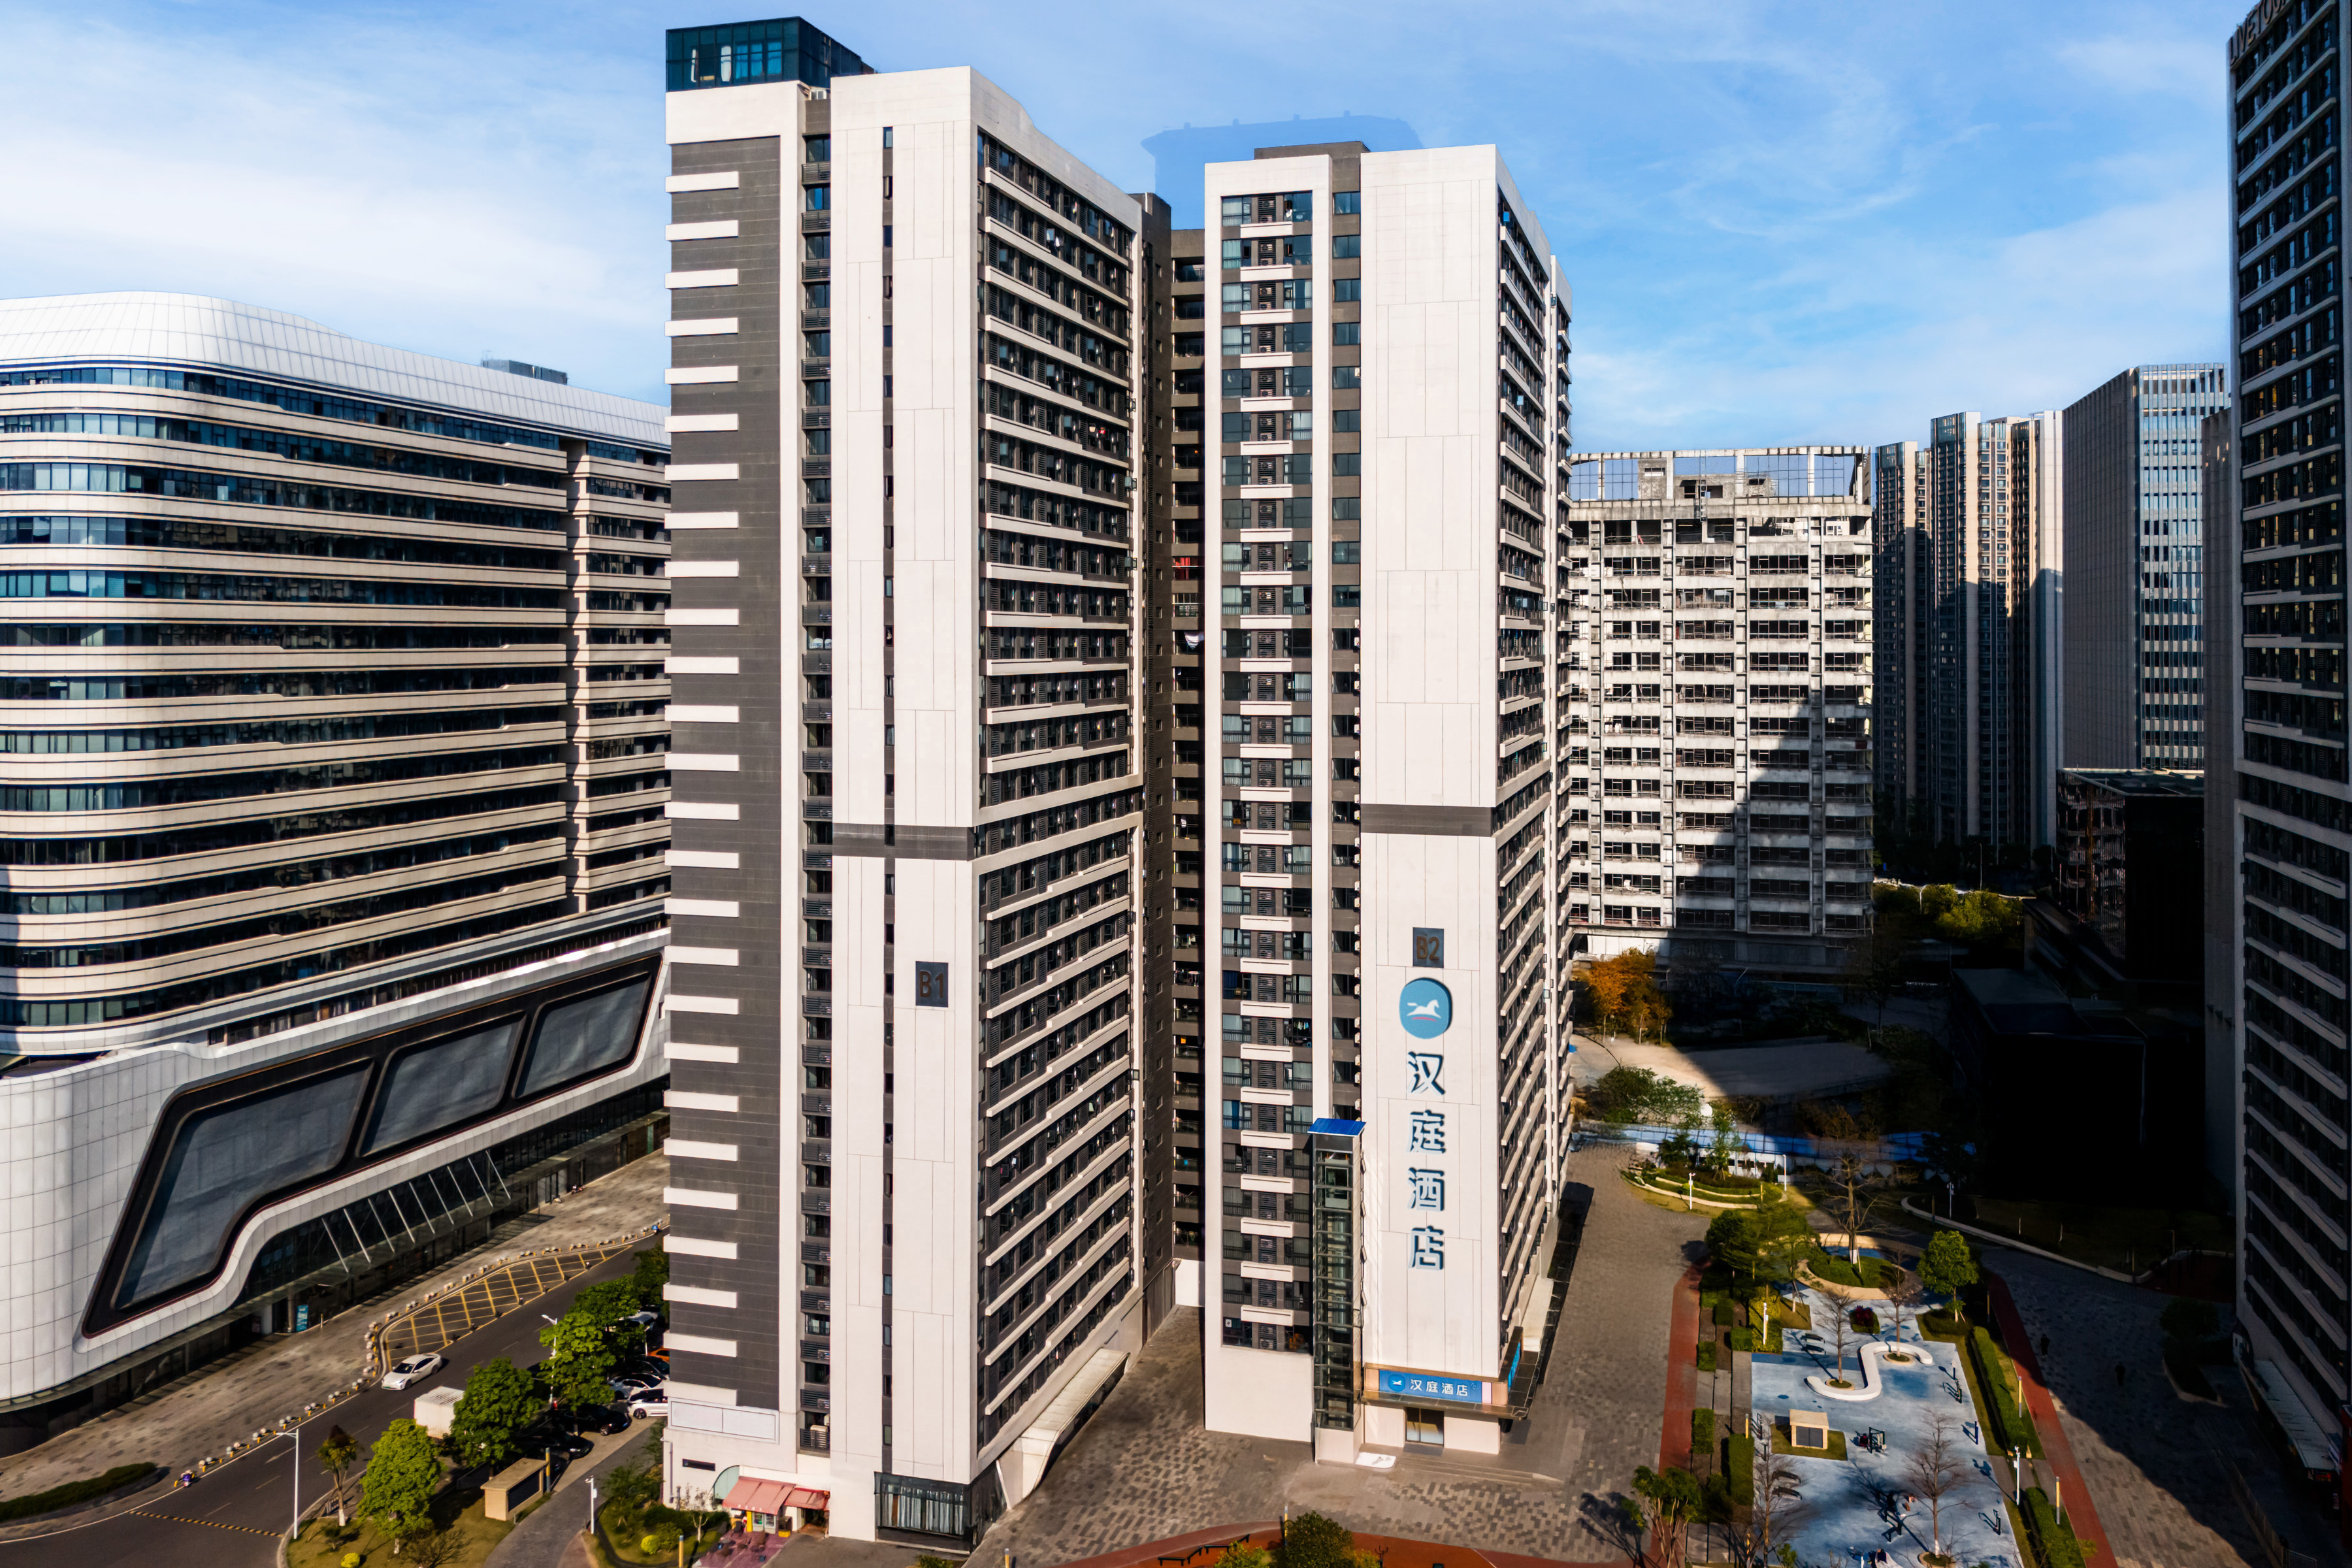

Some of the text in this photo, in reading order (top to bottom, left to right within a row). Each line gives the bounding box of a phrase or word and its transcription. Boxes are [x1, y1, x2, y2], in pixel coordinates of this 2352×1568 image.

[1416, 936, 1440, 961] B2
[919, 970, 943, 998] B1
[1407, 1051, 1446, 1271] 汉庭酒店
[1410, 1379, 1468, 1396] 汉庭酒店
